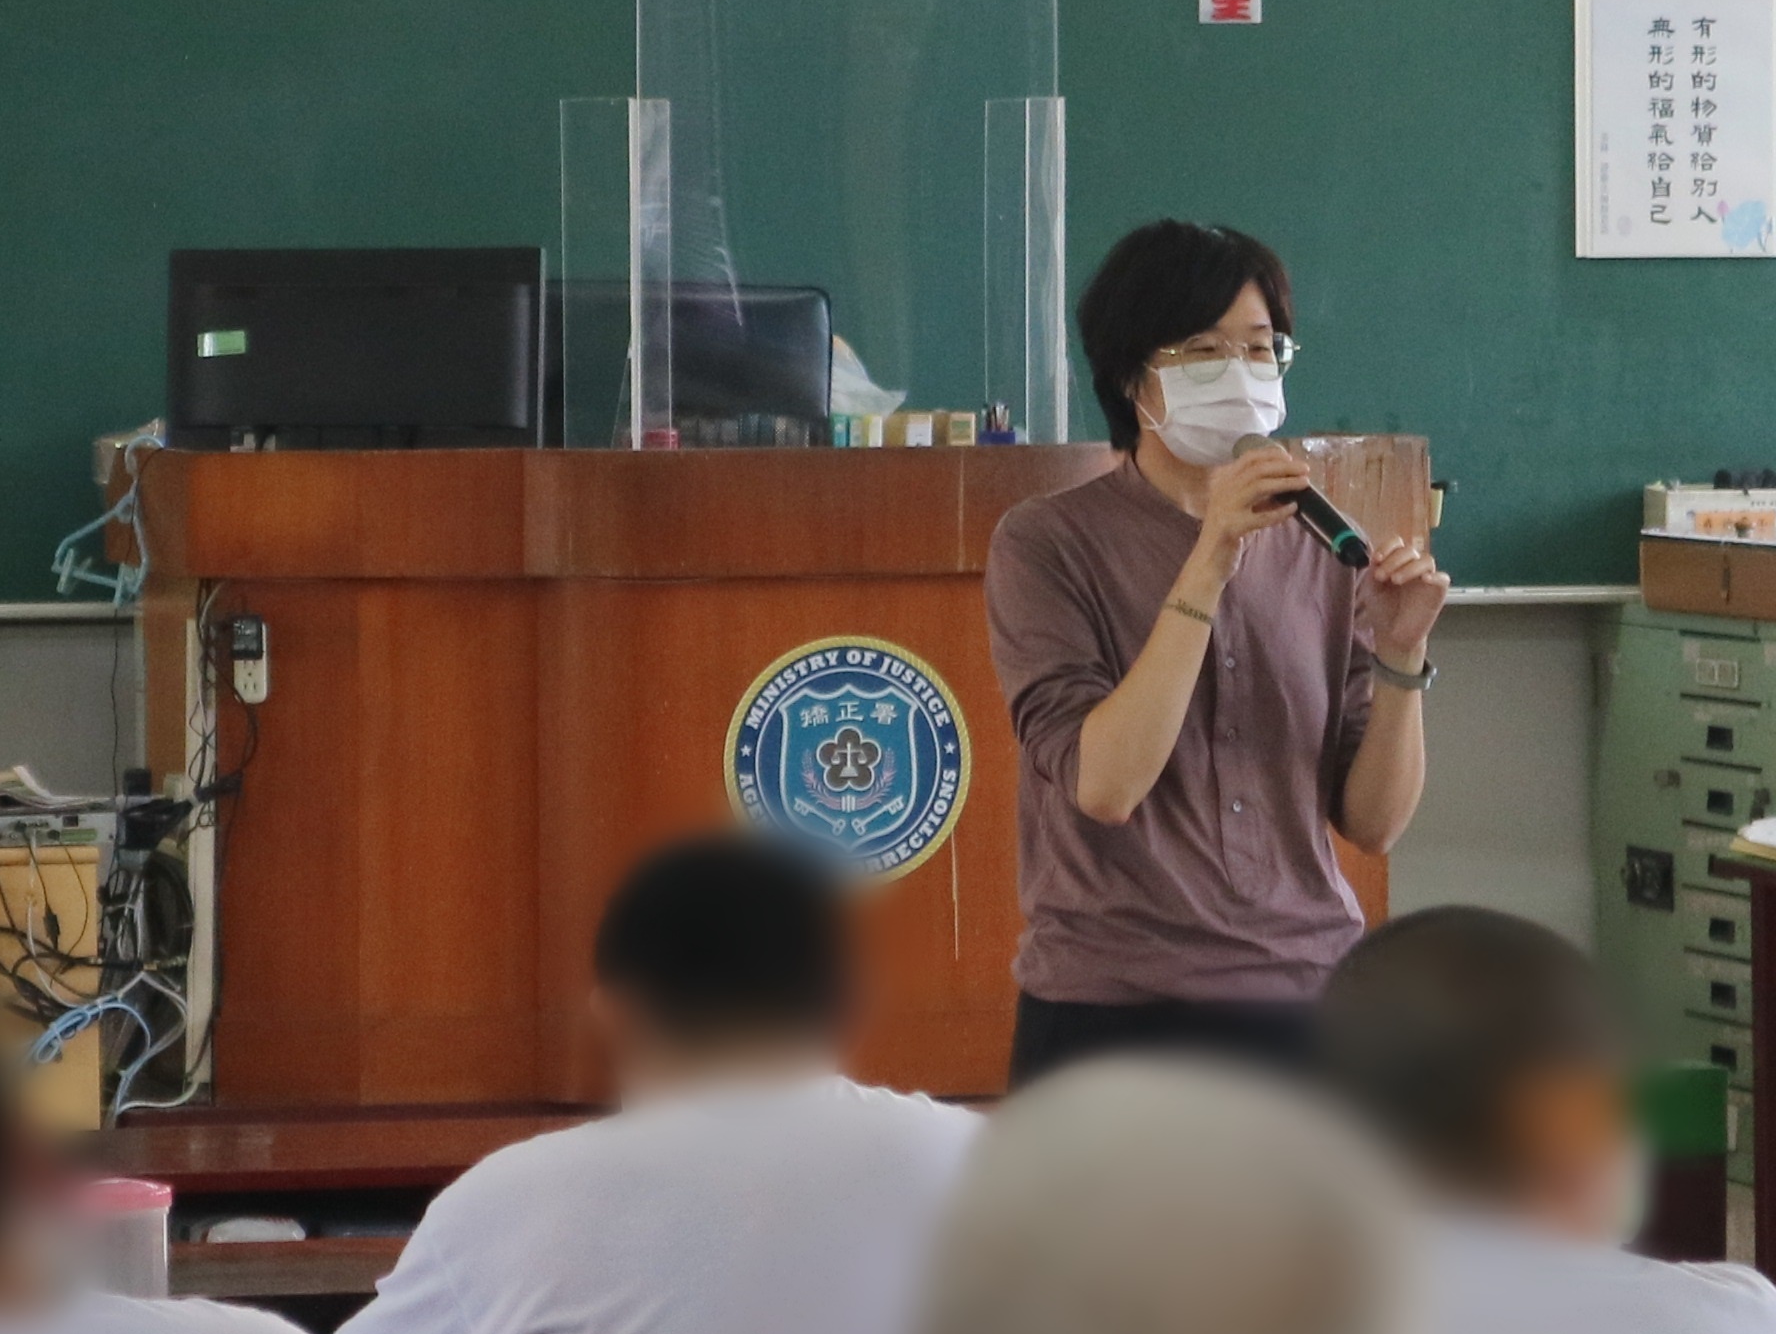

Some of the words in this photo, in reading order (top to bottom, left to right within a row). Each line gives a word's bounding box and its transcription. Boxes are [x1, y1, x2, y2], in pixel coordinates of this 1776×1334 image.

[1647, 15, 1676, 226] 無形的福氣給自己
[1690, 15, 1718, 226] 有形的物質給別人
[744, 650, 839, 731] MINISTRY
[845, 649, 878, 666] OF
[880, 656, 952, 728] JUSTICE
[800, 701, 898, 728] 矯正署
